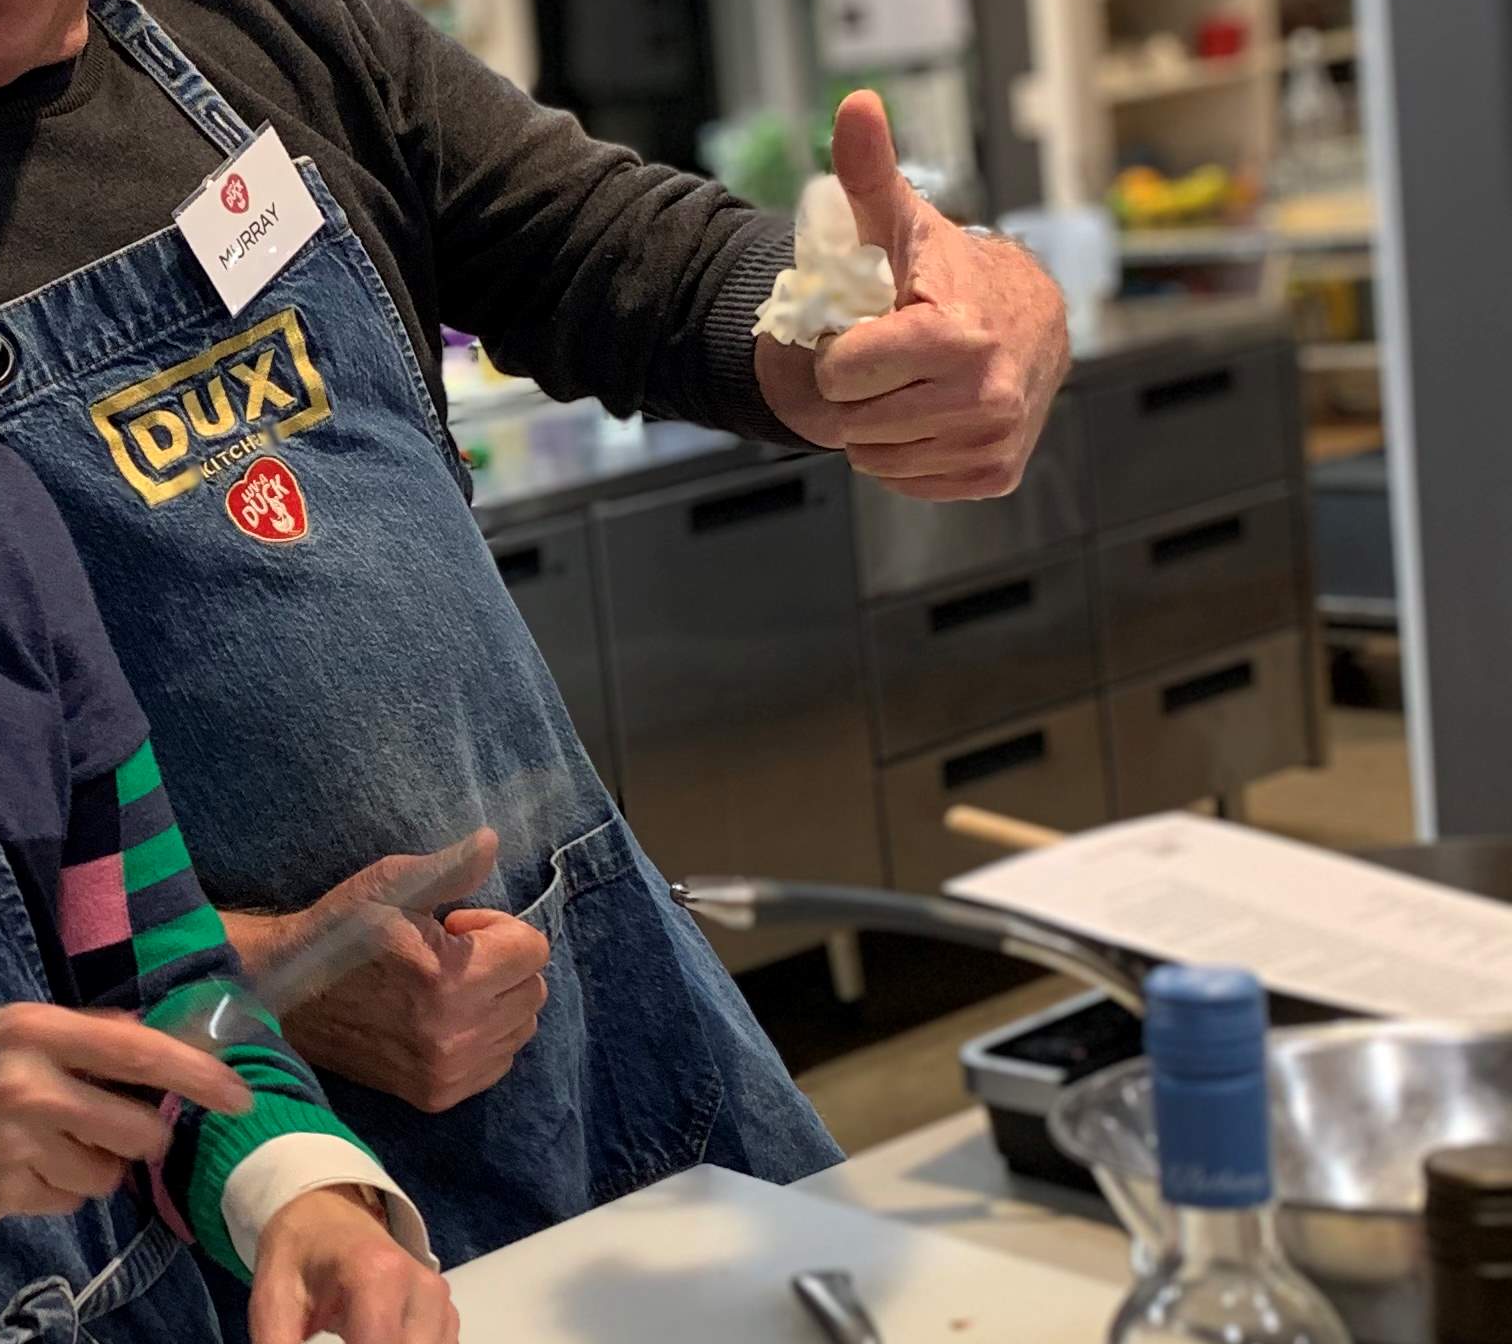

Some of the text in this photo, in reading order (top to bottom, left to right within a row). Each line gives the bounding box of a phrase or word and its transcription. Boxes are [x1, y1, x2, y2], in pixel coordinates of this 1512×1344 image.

[218, 201, 280, 270] MURRAY
[131, 350, 296, 470] DUX
[241, 473, 291, 529] DUCK
